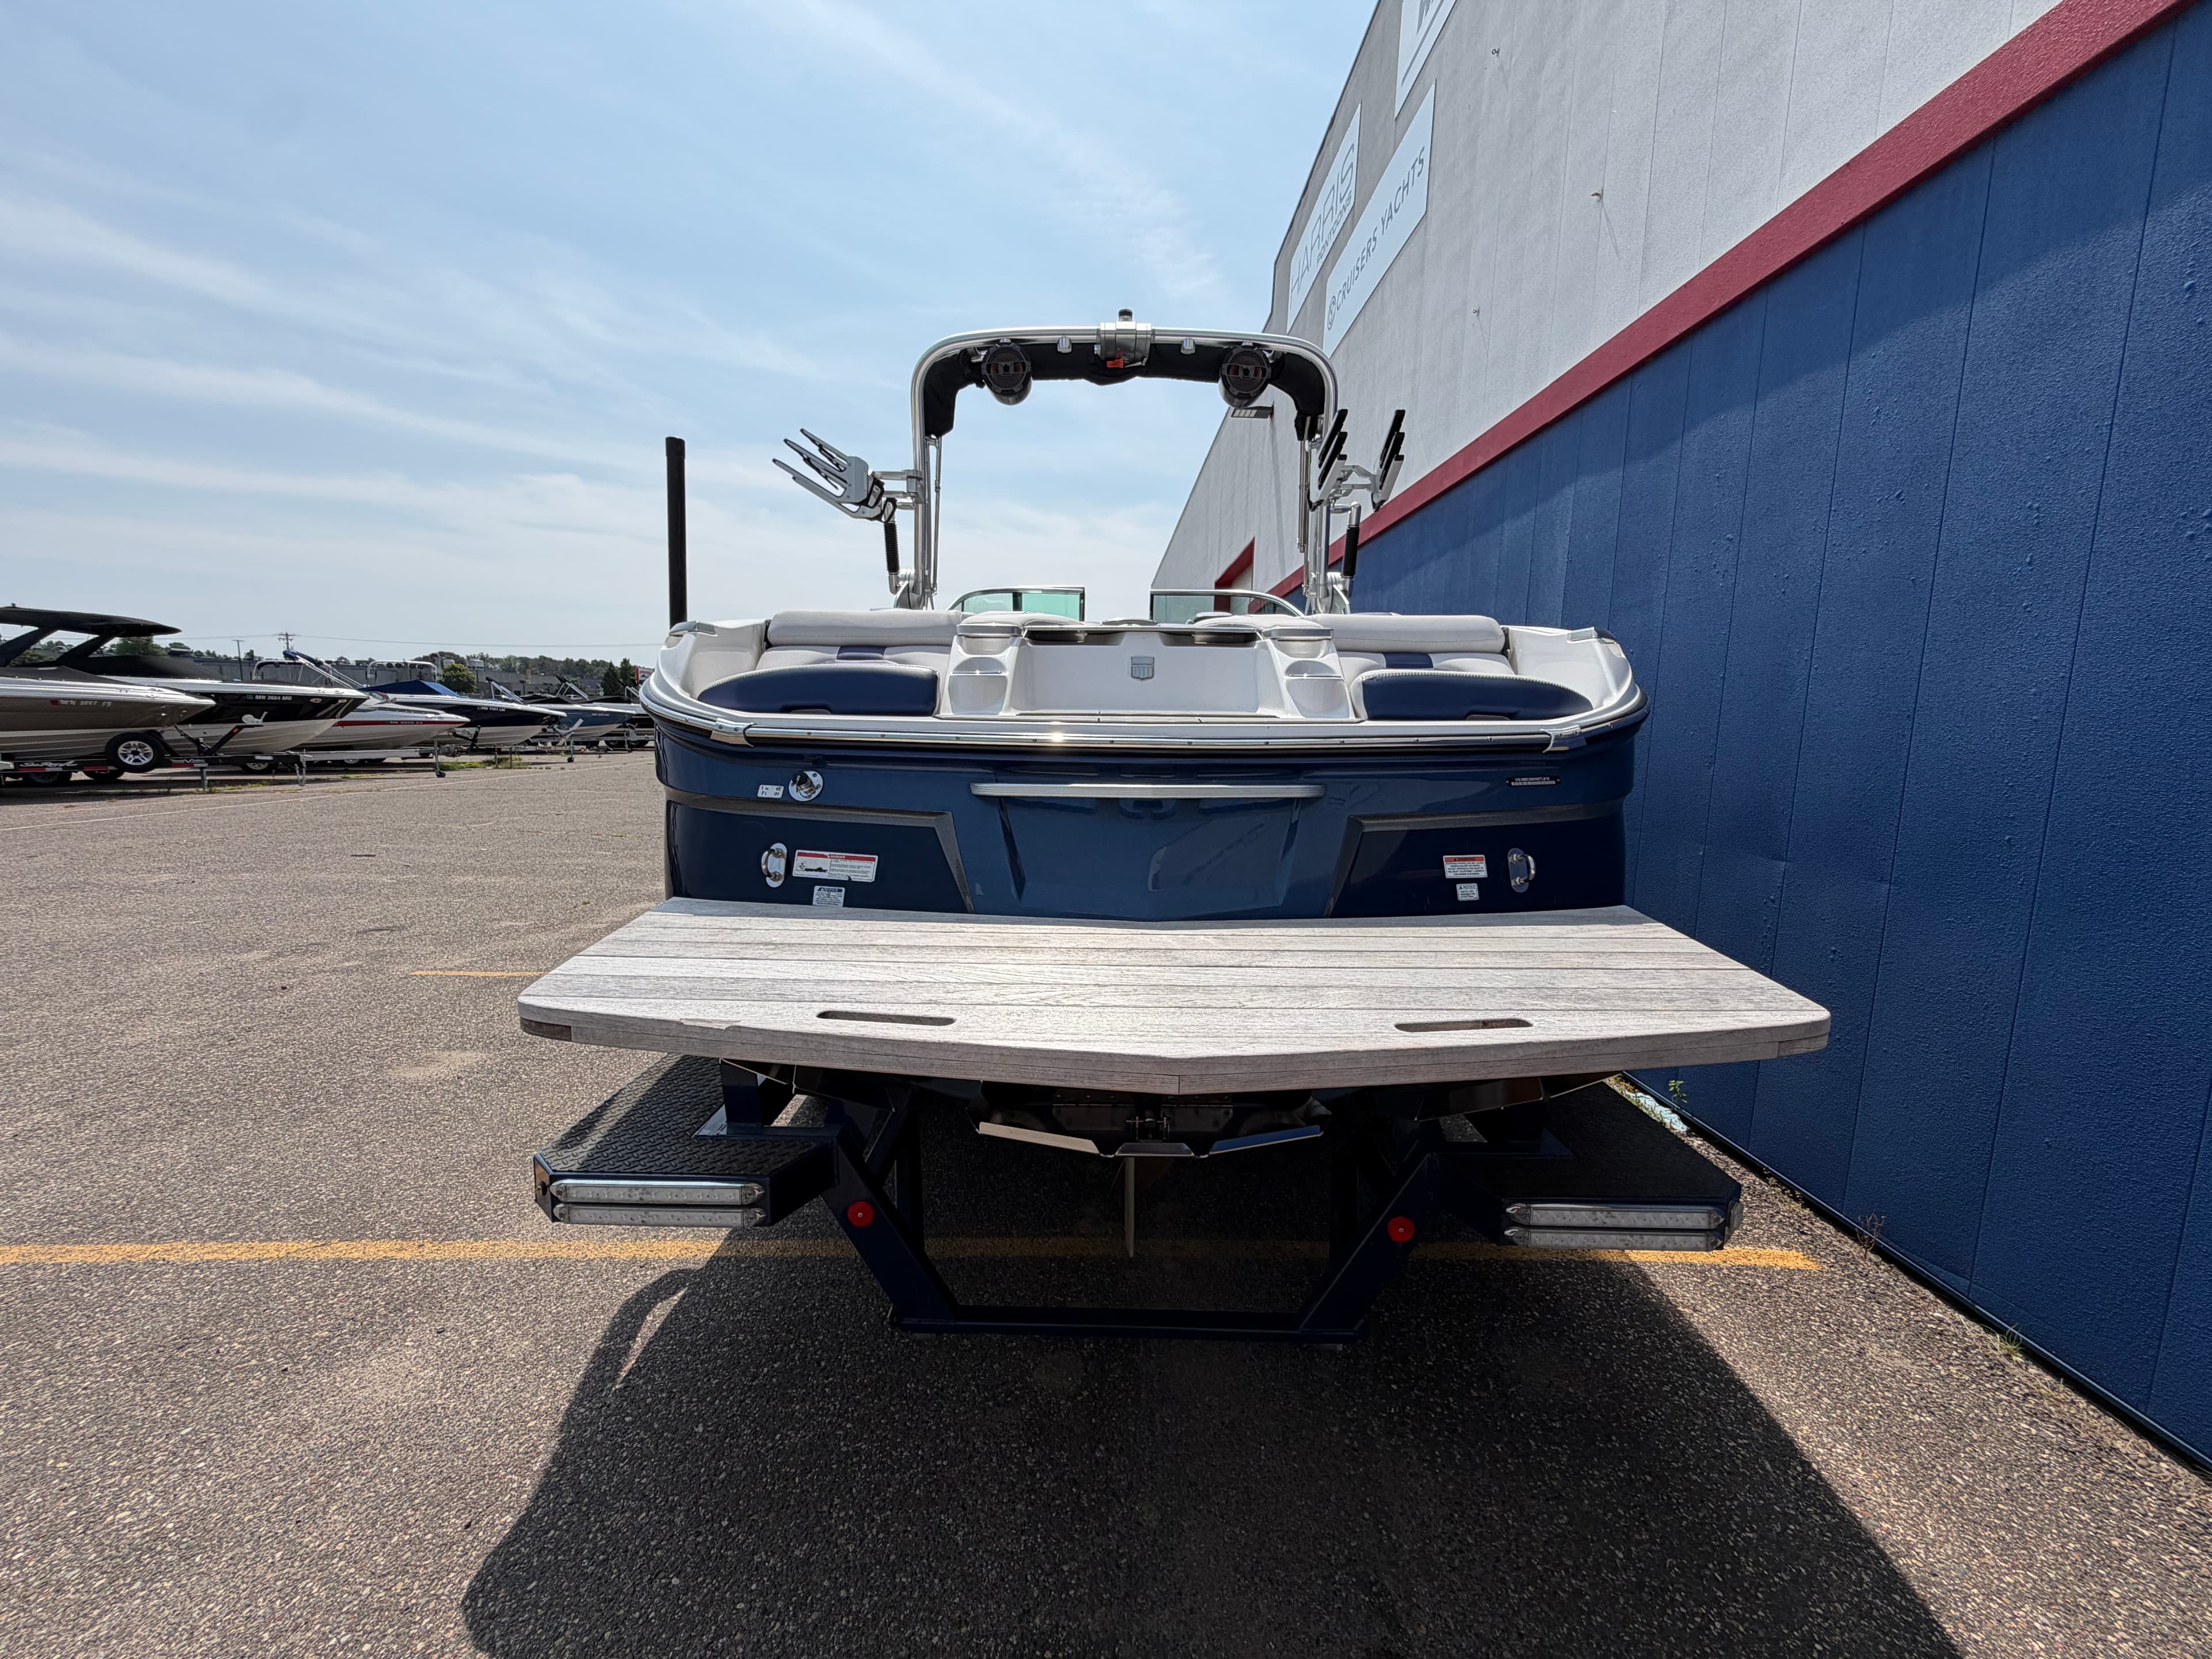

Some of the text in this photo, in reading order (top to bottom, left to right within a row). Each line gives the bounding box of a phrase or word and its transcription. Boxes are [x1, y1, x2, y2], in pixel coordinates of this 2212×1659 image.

[1290, 142, 1354, 309] HARRIS
[1316, 190, 1352, 267] PONTOONS
[1336, 146, 1425, 312] CRUISERS YACHTS
